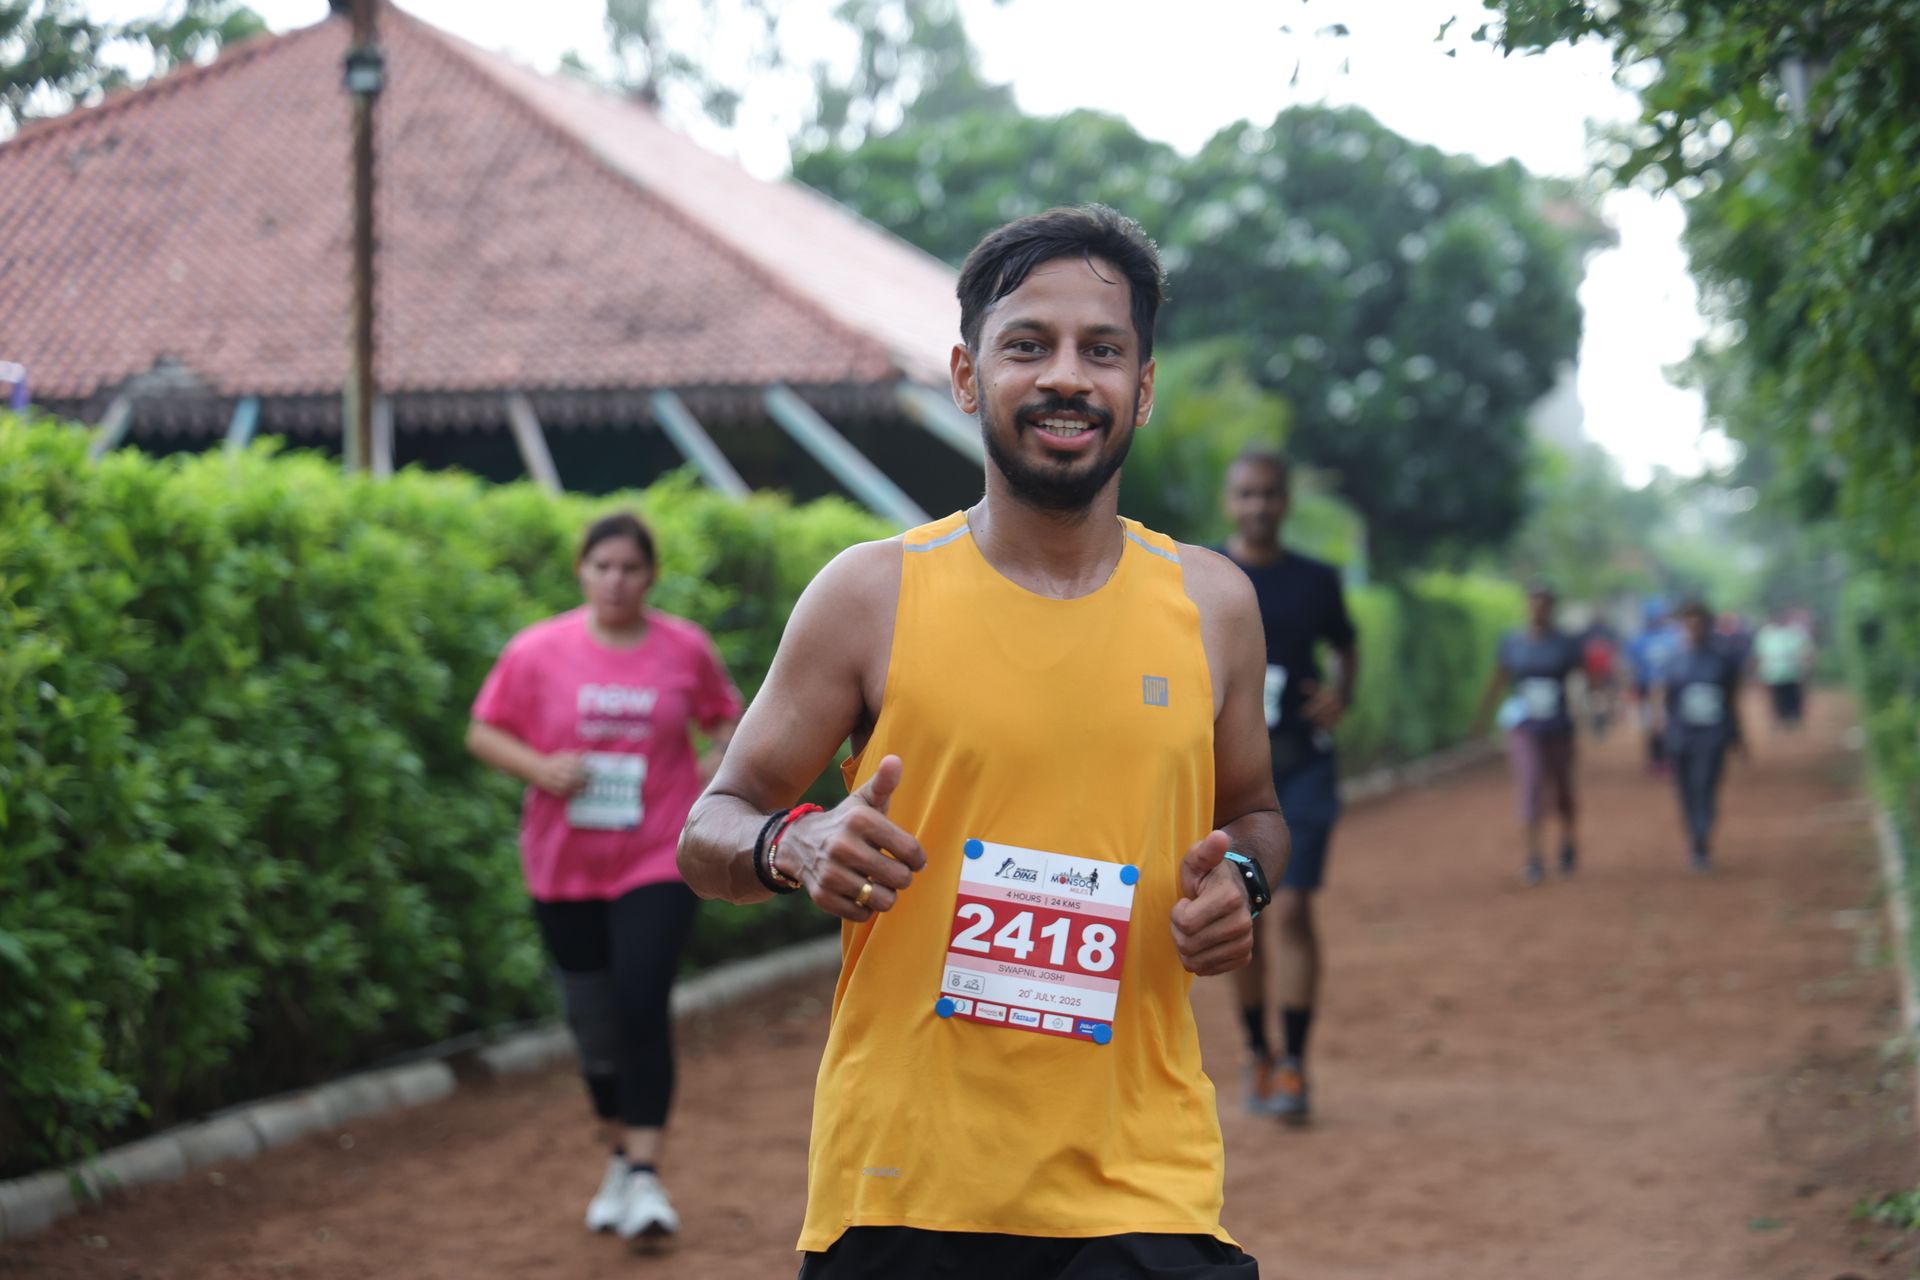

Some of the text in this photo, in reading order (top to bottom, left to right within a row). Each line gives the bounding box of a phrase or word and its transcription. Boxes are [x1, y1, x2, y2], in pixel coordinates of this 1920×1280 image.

[1013, 871, 1037, 881] DINA
[1006, 891, 1012, 899] 4
[1013, 892, 1041, 903] HOURS
[1051, 898, 1061, 906] 24
[1062, 900, 1081, 910] KMS
[951, 903, 1117, 972] 2418
[998, 964, 1065, 982] SWAPNIL JOSHI
[1059, 996, 1081, 1007] 2025
